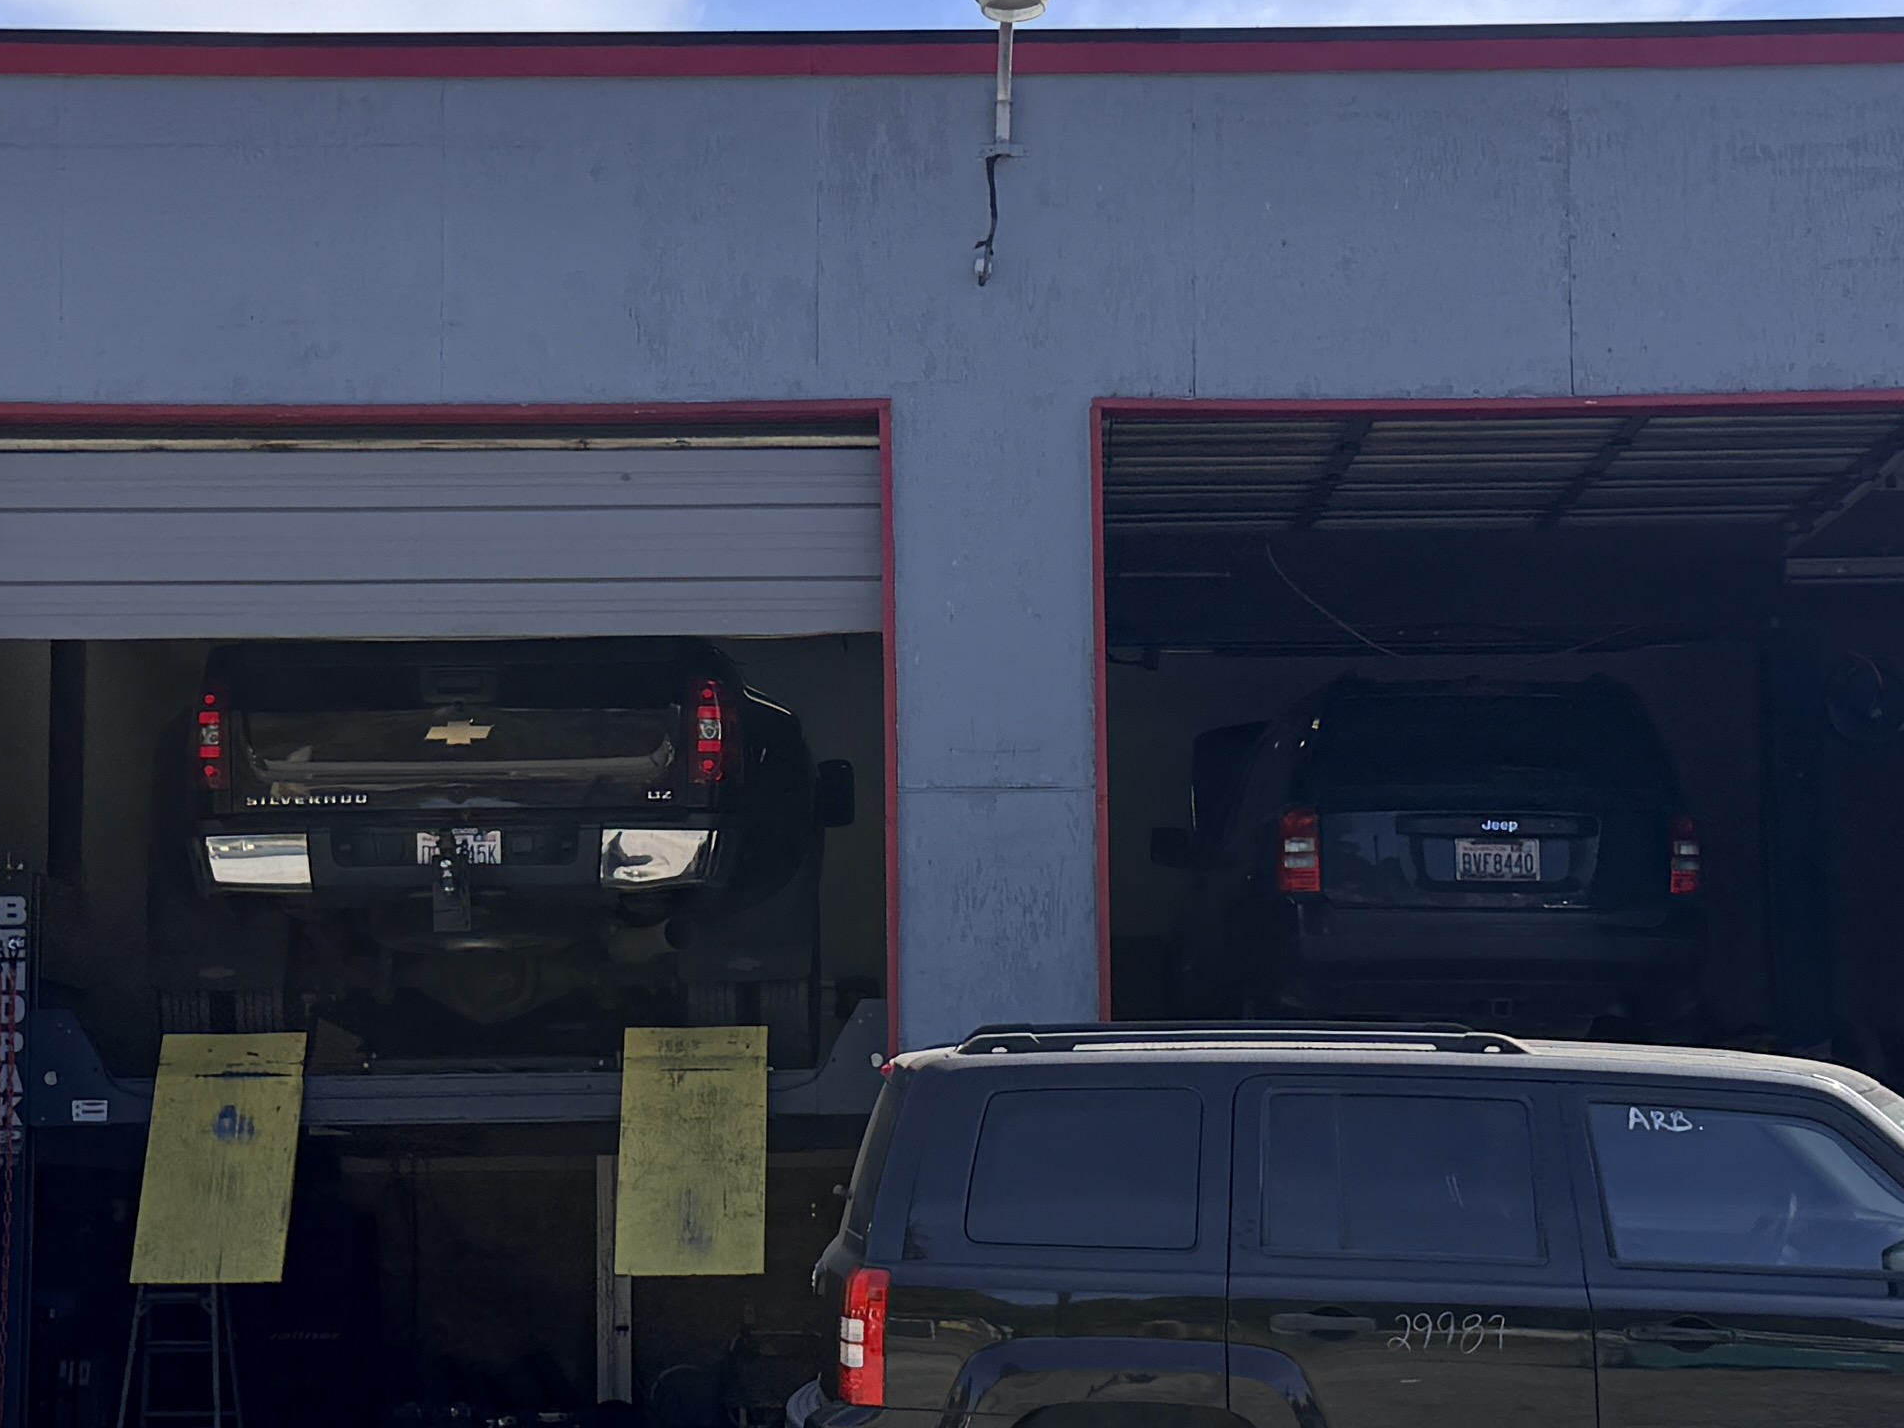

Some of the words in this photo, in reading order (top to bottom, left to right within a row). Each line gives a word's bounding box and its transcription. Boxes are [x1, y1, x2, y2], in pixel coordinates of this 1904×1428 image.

[1481, 819, 1518, 833] Jeep
[1462, 852, 1534, 874] BVF8440
[1386, 1311, 1505, 1354] 29987
